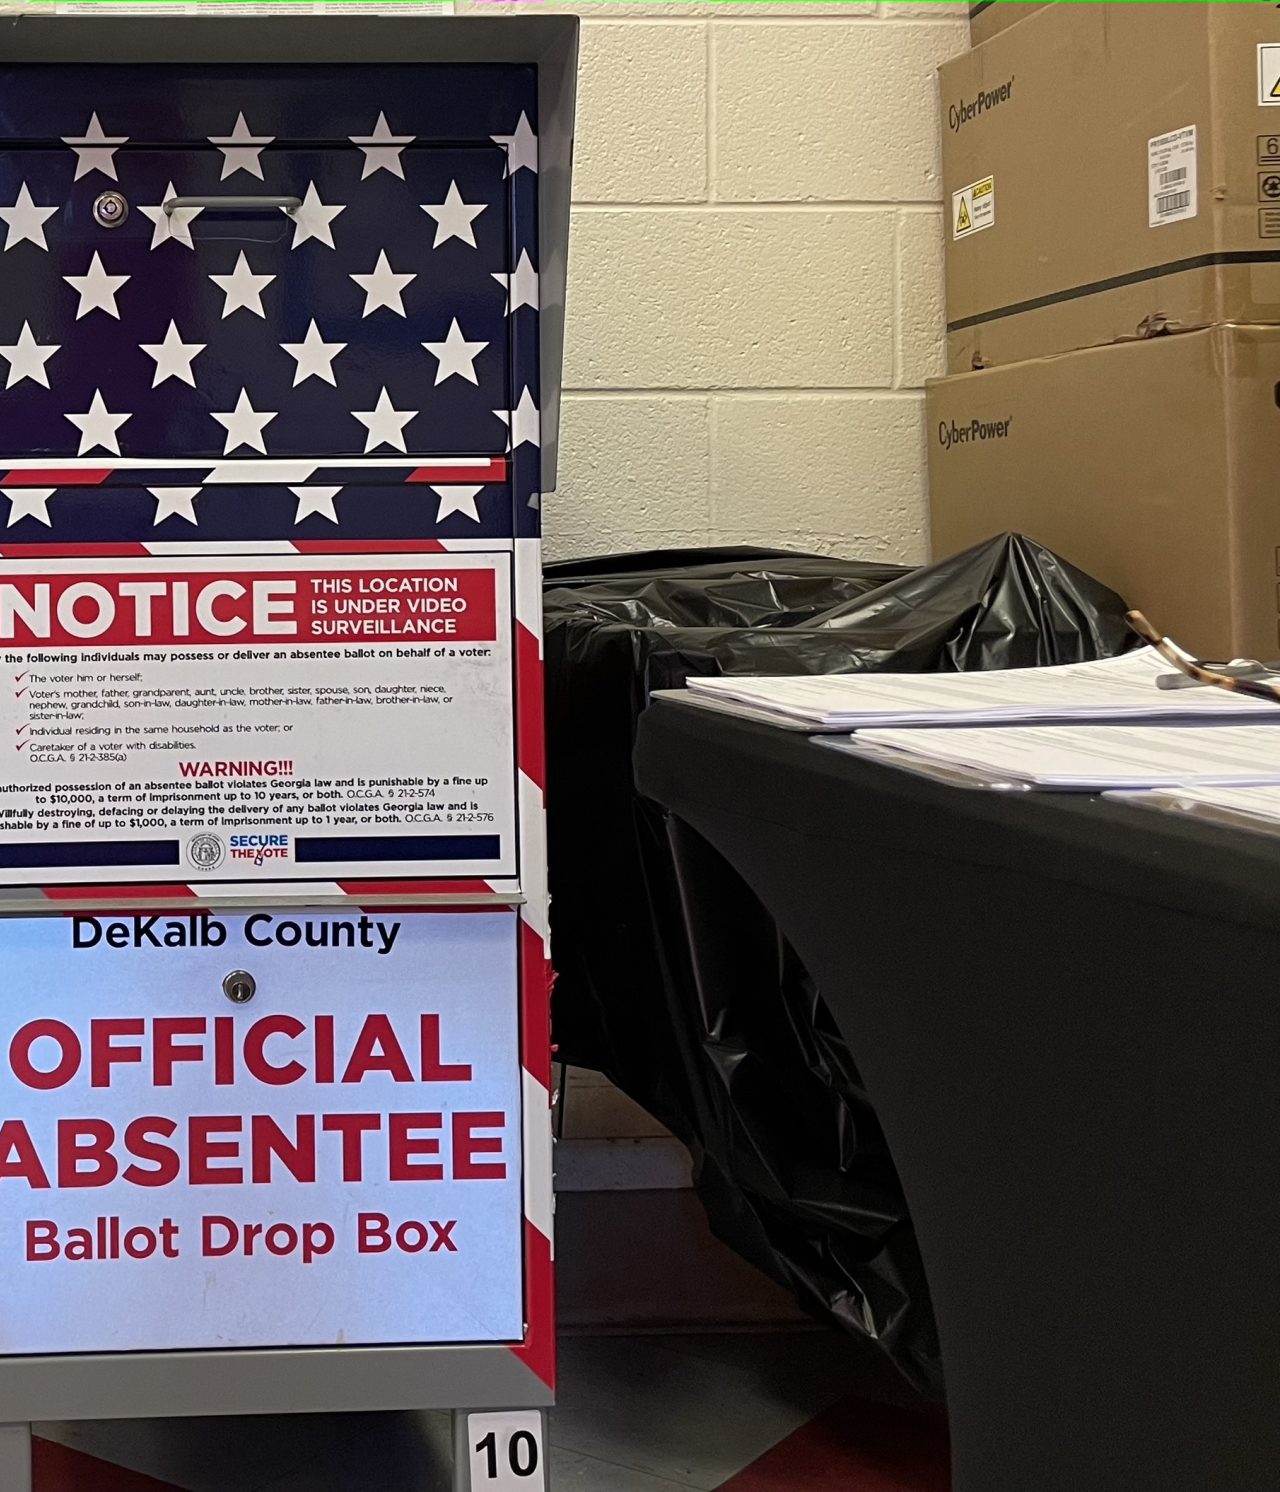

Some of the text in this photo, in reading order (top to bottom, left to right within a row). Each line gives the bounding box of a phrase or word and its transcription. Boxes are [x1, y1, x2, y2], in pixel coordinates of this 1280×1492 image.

[949, 79, 1013, 133] CyberPower
[939, 419, 1010, 450] CyberPower
[311, 577, 458, 594] THIS LOCATION
[311, 597, 467, 614] IS UNDER VIDEO
[311, 618, 457, 635] SURVEILLANCE
[4, 653, 22, 663] the
[26, 652, 77, 664] following
[143, 653, 166, 662] may
[170, 652, 214, 662] possess
[232, 650, 270, 659] deliver
[290, 649, 340, 659] absentee
[344, 648, 375, 658] ballot
[396, 647, 430, 657] behalf
[434, 647, 445, 657] of
[458, 648, 491, 656] voter:
[29, 674, 46, 682] The
[30, 727, 71, 735] Individual
[75, 726, 110, 736] residing
[125, 725, 140, 733] the
[172, 724, 219, 733] household
[236, 724, 251, 732] the
[29, 743, 74, 751] Caretaker
[77, 742, 86, 750] of
[98, 742, 122, 750] voter
[126, 741, 146, 749] with
[148, 740, 196, 749] disabilities.
[178, 760, 293, 777] WARNING!!!
[55, 781, 111, 793] possession
[114, 781, 125, 790] of
[144, 780, 192, 790] absentee
[195, 780, 224, 789] ballot
[227, 779, 266, 788] violates
[270, 778, 310, 789] Georgia
[314, 778, 332, 787] law
[335, 778, 354, 786] and
[368, 776, 423, 789] punishable
[427, 776, 439, 787] by
[452, 776, 471, 785] fine
[474, 778, 487, 786] up
[35, 795, 46, 803] to
[107, 794, 132, 802] term
[135, 793, 146, 801] of
[224, 793, 237, 801] up
[240, 792, 251, 800] to
[254, 791, 266, 799] 10
[316, 789, 343, 798] both.
[98, 806, 143, 817] defacing
[161, 805, 204, 816] delaying
[208, 805, 224, 814] the
[228, 804, 269, 815] delivery
[272, 804, 283, 813] of
[286, 805, 304, 814] any
[308, 803, 336, 812] ballot
[339, 802, 379, 811] violates
[382, 802, 423, 814] Georgia
[426, 801, 444, 810] law
[448, 801, 466, 810] and
[230, 835, 288, 847] SECURE
[230, 849, 255, 858] THE
[72, 914, 401, 954] DeKalb County
[9, 1014, 472, 1090] OFFICIAL
[25, 1213, 458, 1264] Ballot Drop Box
[475, 1430, 538, 1480] 10
